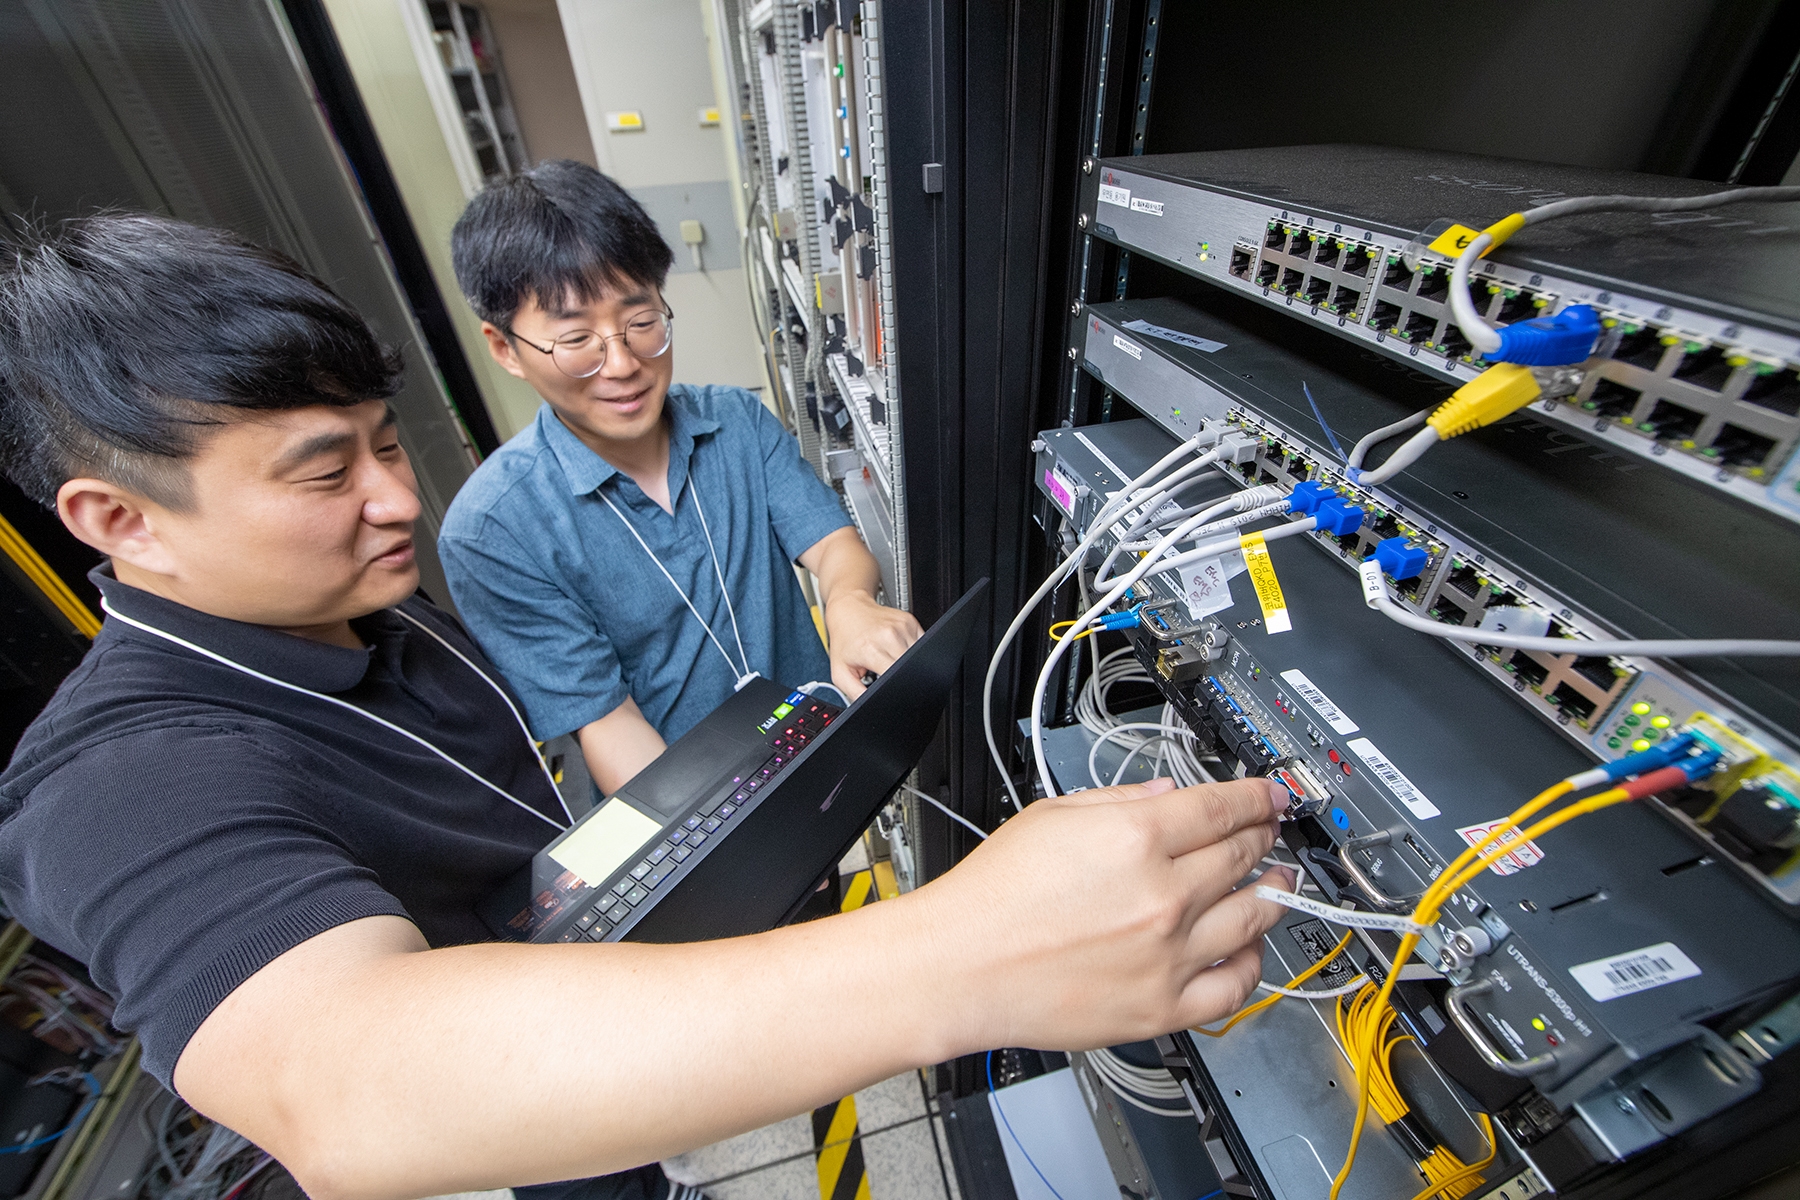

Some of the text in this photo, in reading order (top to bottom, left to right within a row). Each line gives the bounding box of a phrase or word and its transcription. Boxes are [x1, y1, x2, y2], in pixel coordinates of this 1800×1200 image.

[1369, 571, 1379, 590] B-01
[1370, 858, 1383, 874] DEBUG
[1428, 864, 1444, 881] DEBUG
[1490, 968, 1512, 992] FAN
